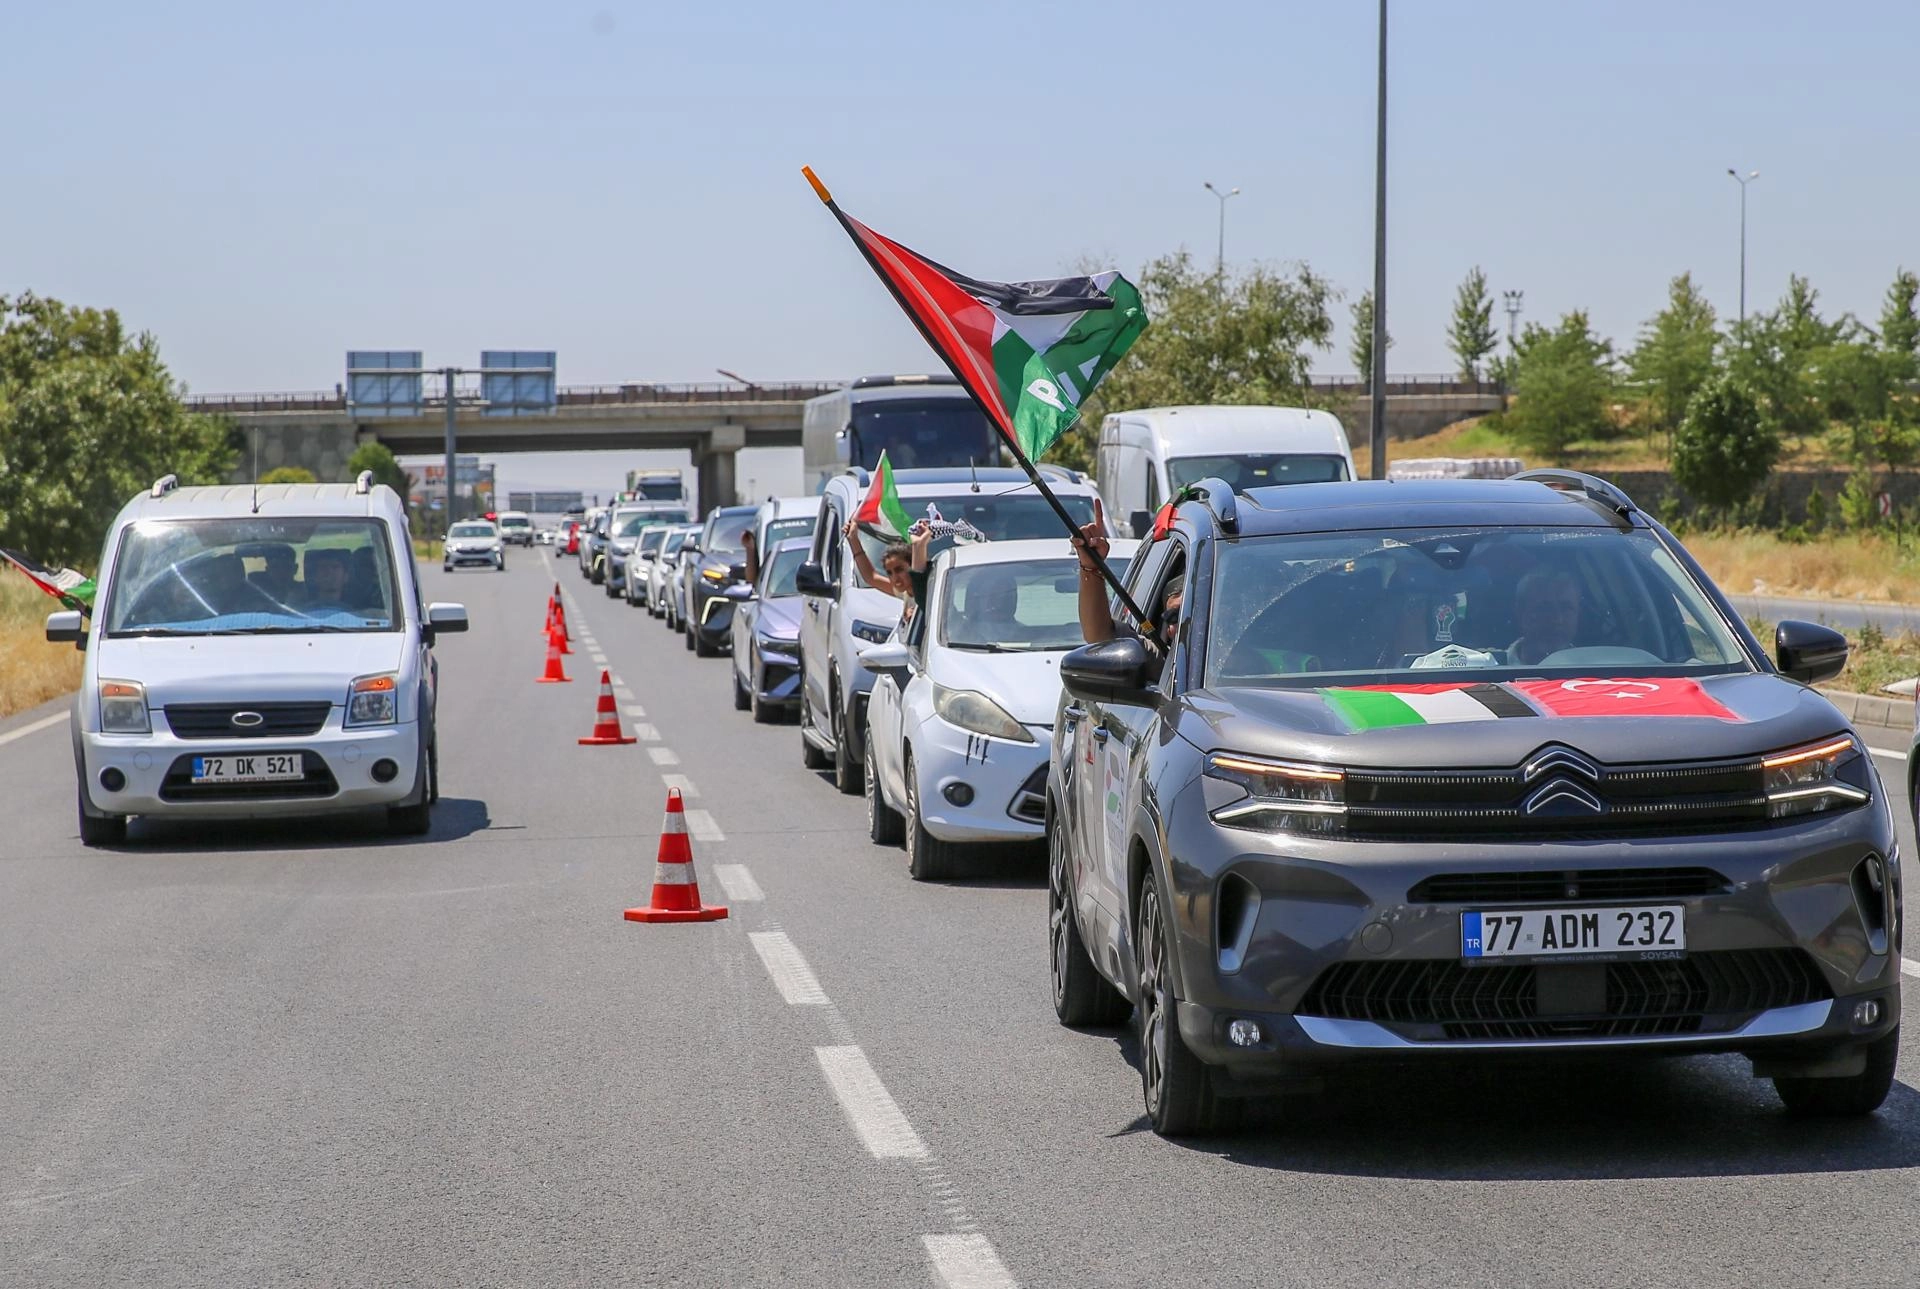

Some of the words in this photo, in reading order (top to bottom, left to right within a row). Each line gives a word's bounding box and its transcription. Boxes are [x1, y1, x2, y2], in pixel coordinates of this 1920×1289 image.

[204, 759, 224, 777] 72
[236, 757, 255, 775] DK
[266, 756, 294, 774] 521
[1466, 938, 1480, 949] TR
[1485, 915, 1524, 951] 77
[1541, 913, 1599, 950] ADM
[1616, 911, 1677, 947] 232
[1639, 950, 1683, 961] SOYSAL
